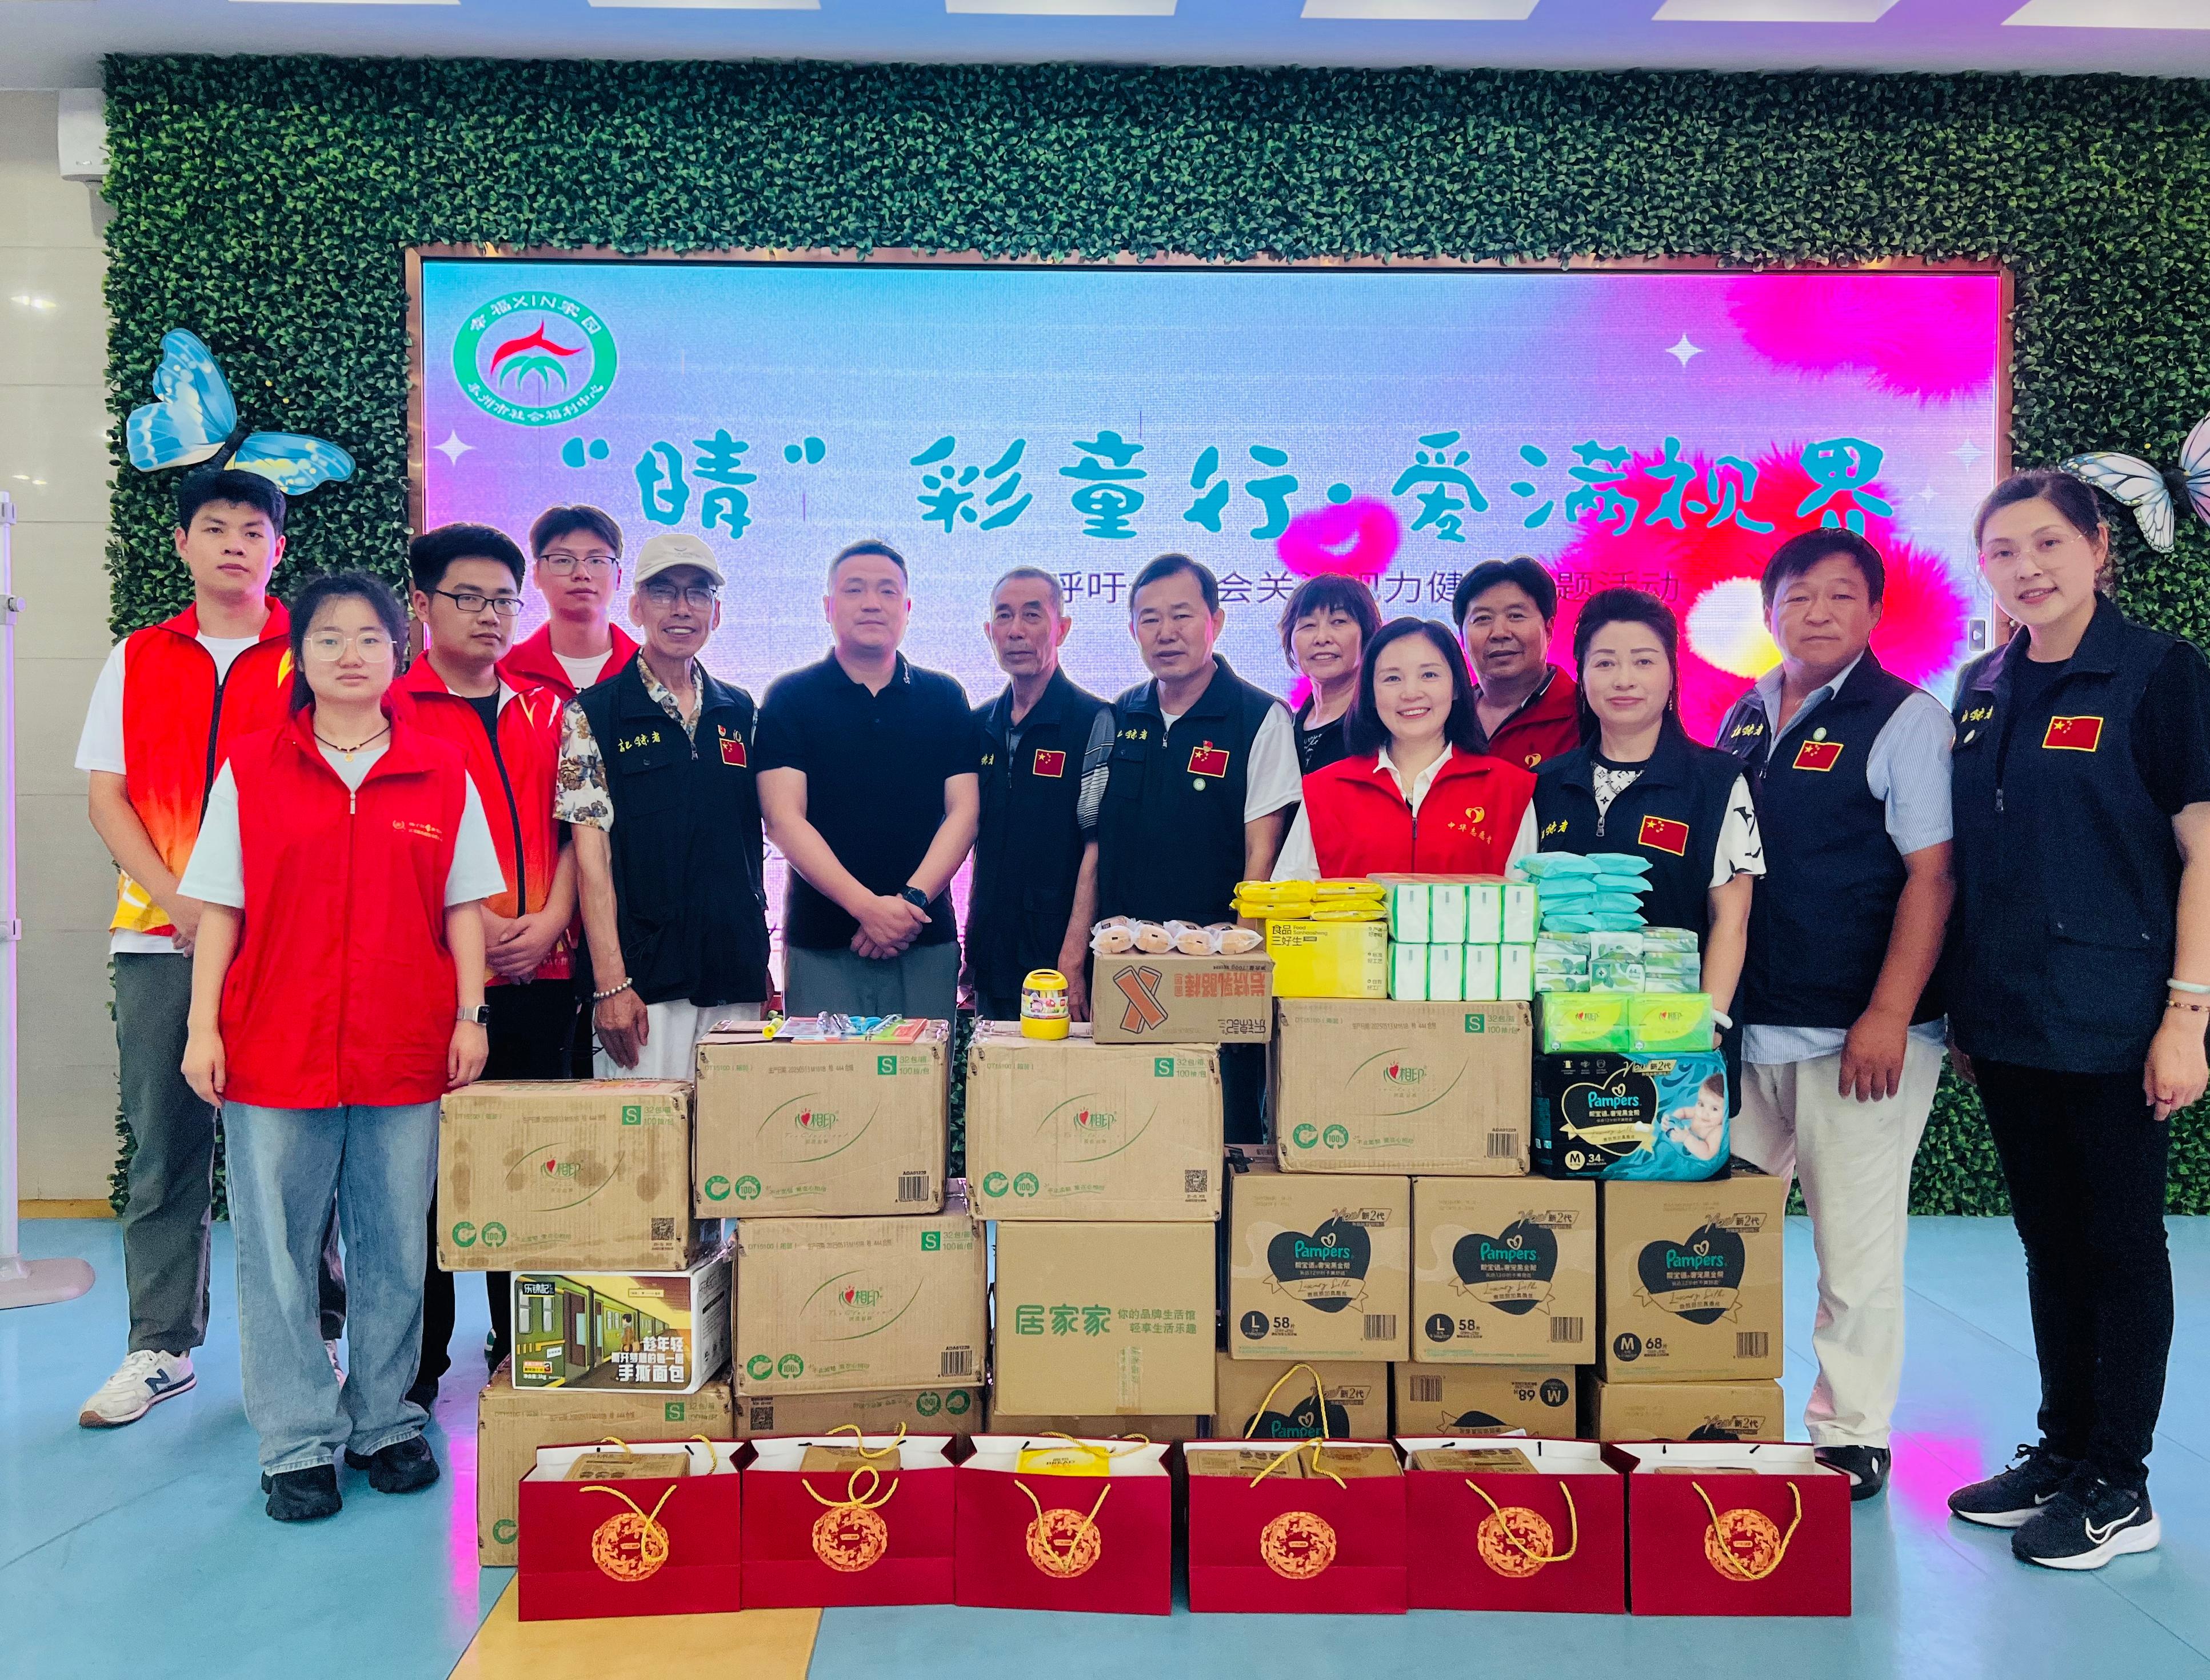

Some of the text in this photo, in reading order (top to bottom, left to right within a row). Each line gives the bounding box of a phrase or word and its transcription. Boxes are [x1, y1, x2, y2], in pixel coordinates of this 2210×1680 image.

[1272, 924, 1292, 935] 食品
[1271, 936, 1302, 947] 三好生
[1588, 1091, 1640, 1110] Pampers
[1569, 1154, 1581, 1164] M
[1294, 1240, 1352, 1261] Pampers
[1480, 1242, 1537, 1263] Pampers
[1666, 1249, 1725, 1270] Pampers
[1015, 1303, 1112, 1337] 居家家
[1117, 1308, 1196, 1321] 你的品牌生活馆
[1251, 1315, 1260, 1329] L
[1436, 1317, 1445, 1331] L
[1620, 1337, 1634, 1351] M
[618, 1365, 685, 1383] 手撕面包
[1271, 1420, 1324, 1439] Pamper
